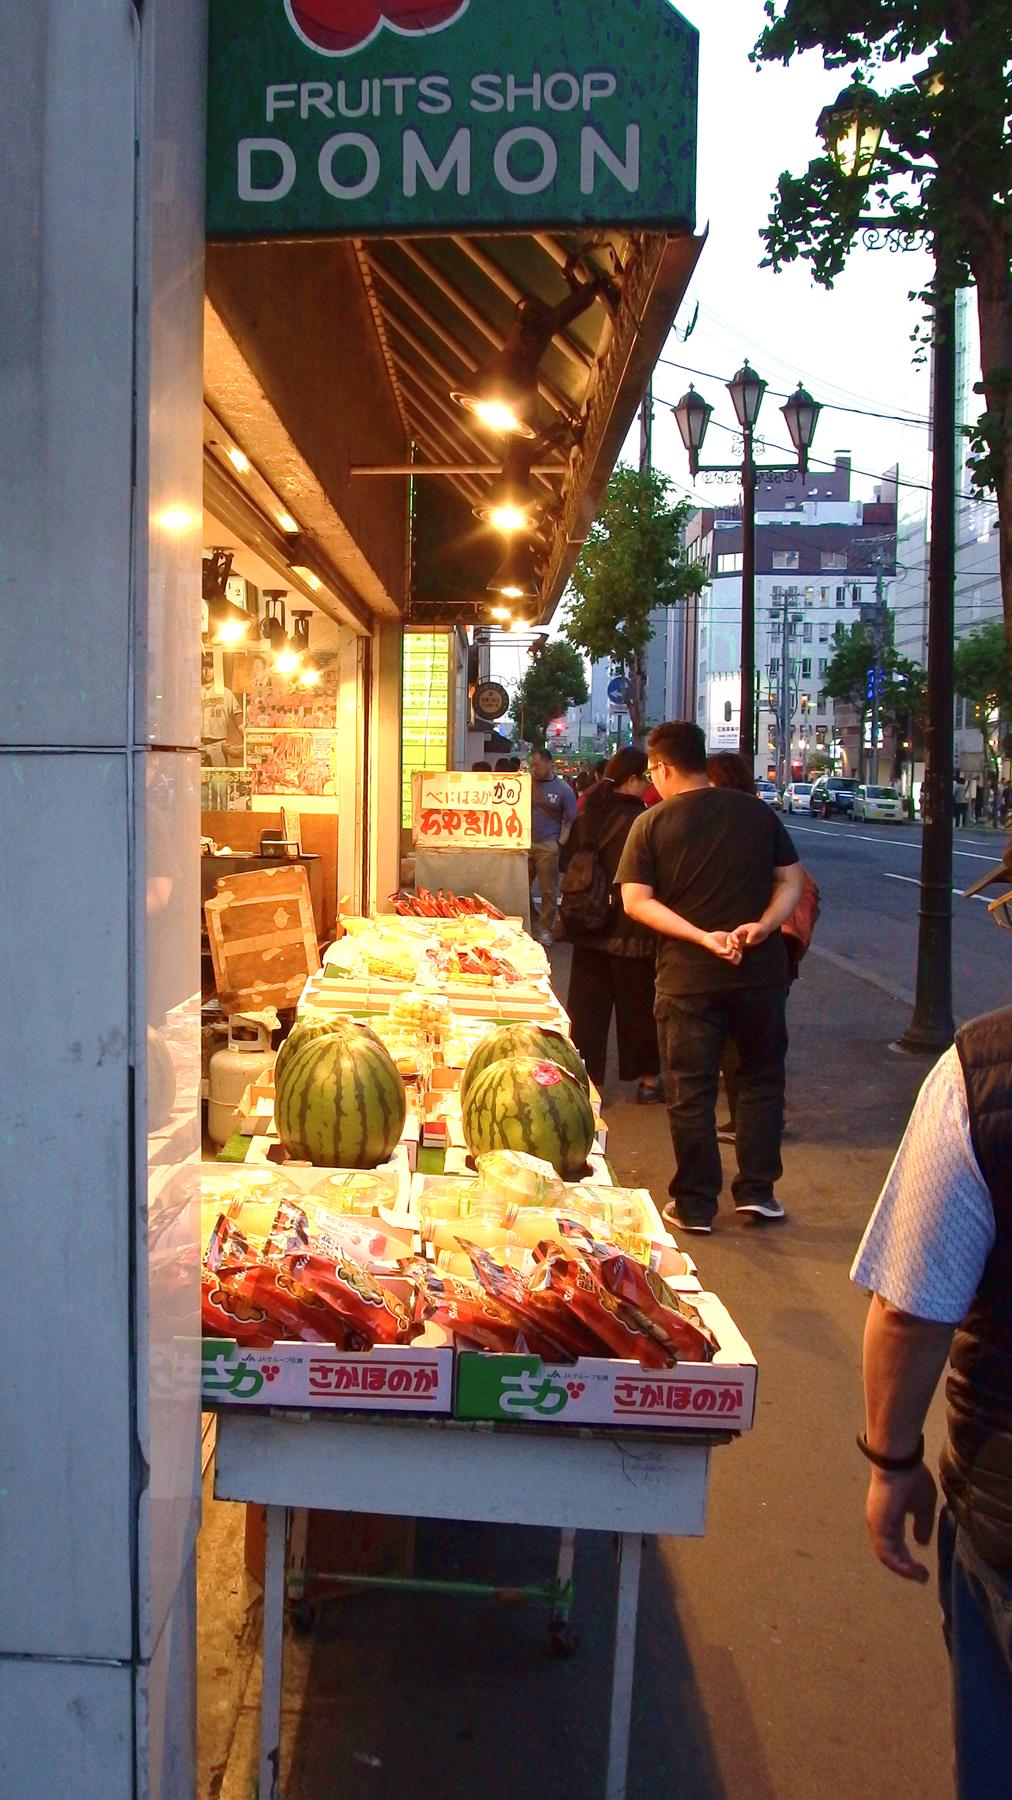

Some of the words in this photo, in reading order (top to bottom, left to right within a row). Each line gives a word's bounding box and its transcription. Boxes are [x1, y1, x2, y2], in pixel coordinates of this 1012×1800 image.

[265, 75, 453, 122] FRUITS
[469, 72, 618, 113] SHOP
[237, 123, 641, 203] DOMON
